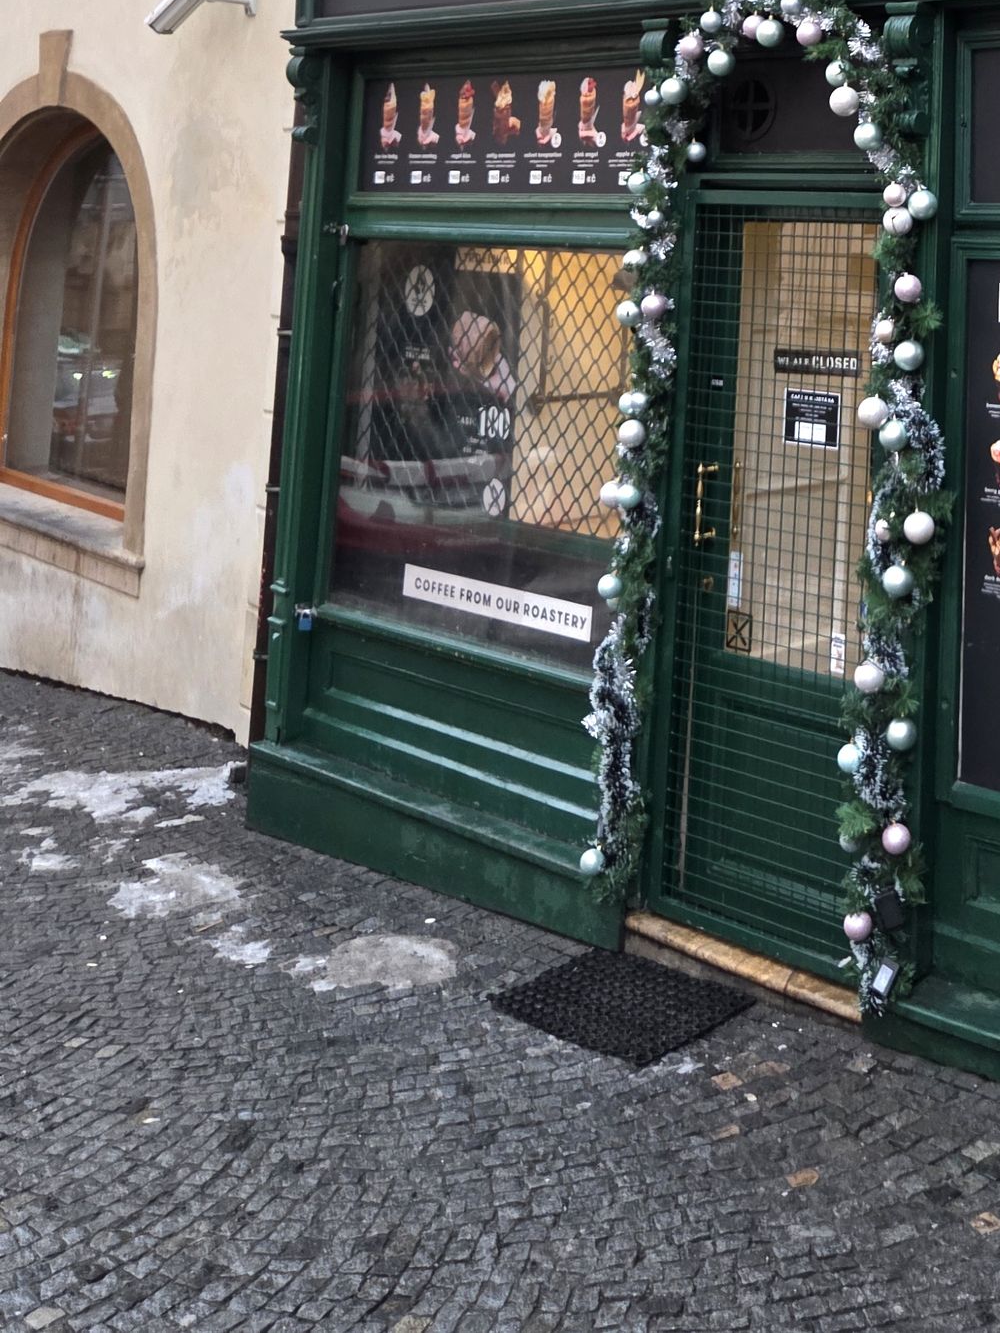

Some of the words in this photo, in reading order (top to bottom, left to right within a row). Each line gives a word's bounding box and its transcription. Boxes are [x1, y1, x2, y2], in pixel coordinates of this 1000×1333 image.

[812, 355, 857, 371] CLOSED
[414, 577, 456, 598] COFFEE
[459, 587, 492, 607] FROM
[495, 597, 520, 615] OUR
[523, 603, 587, 630] ROASTERY
